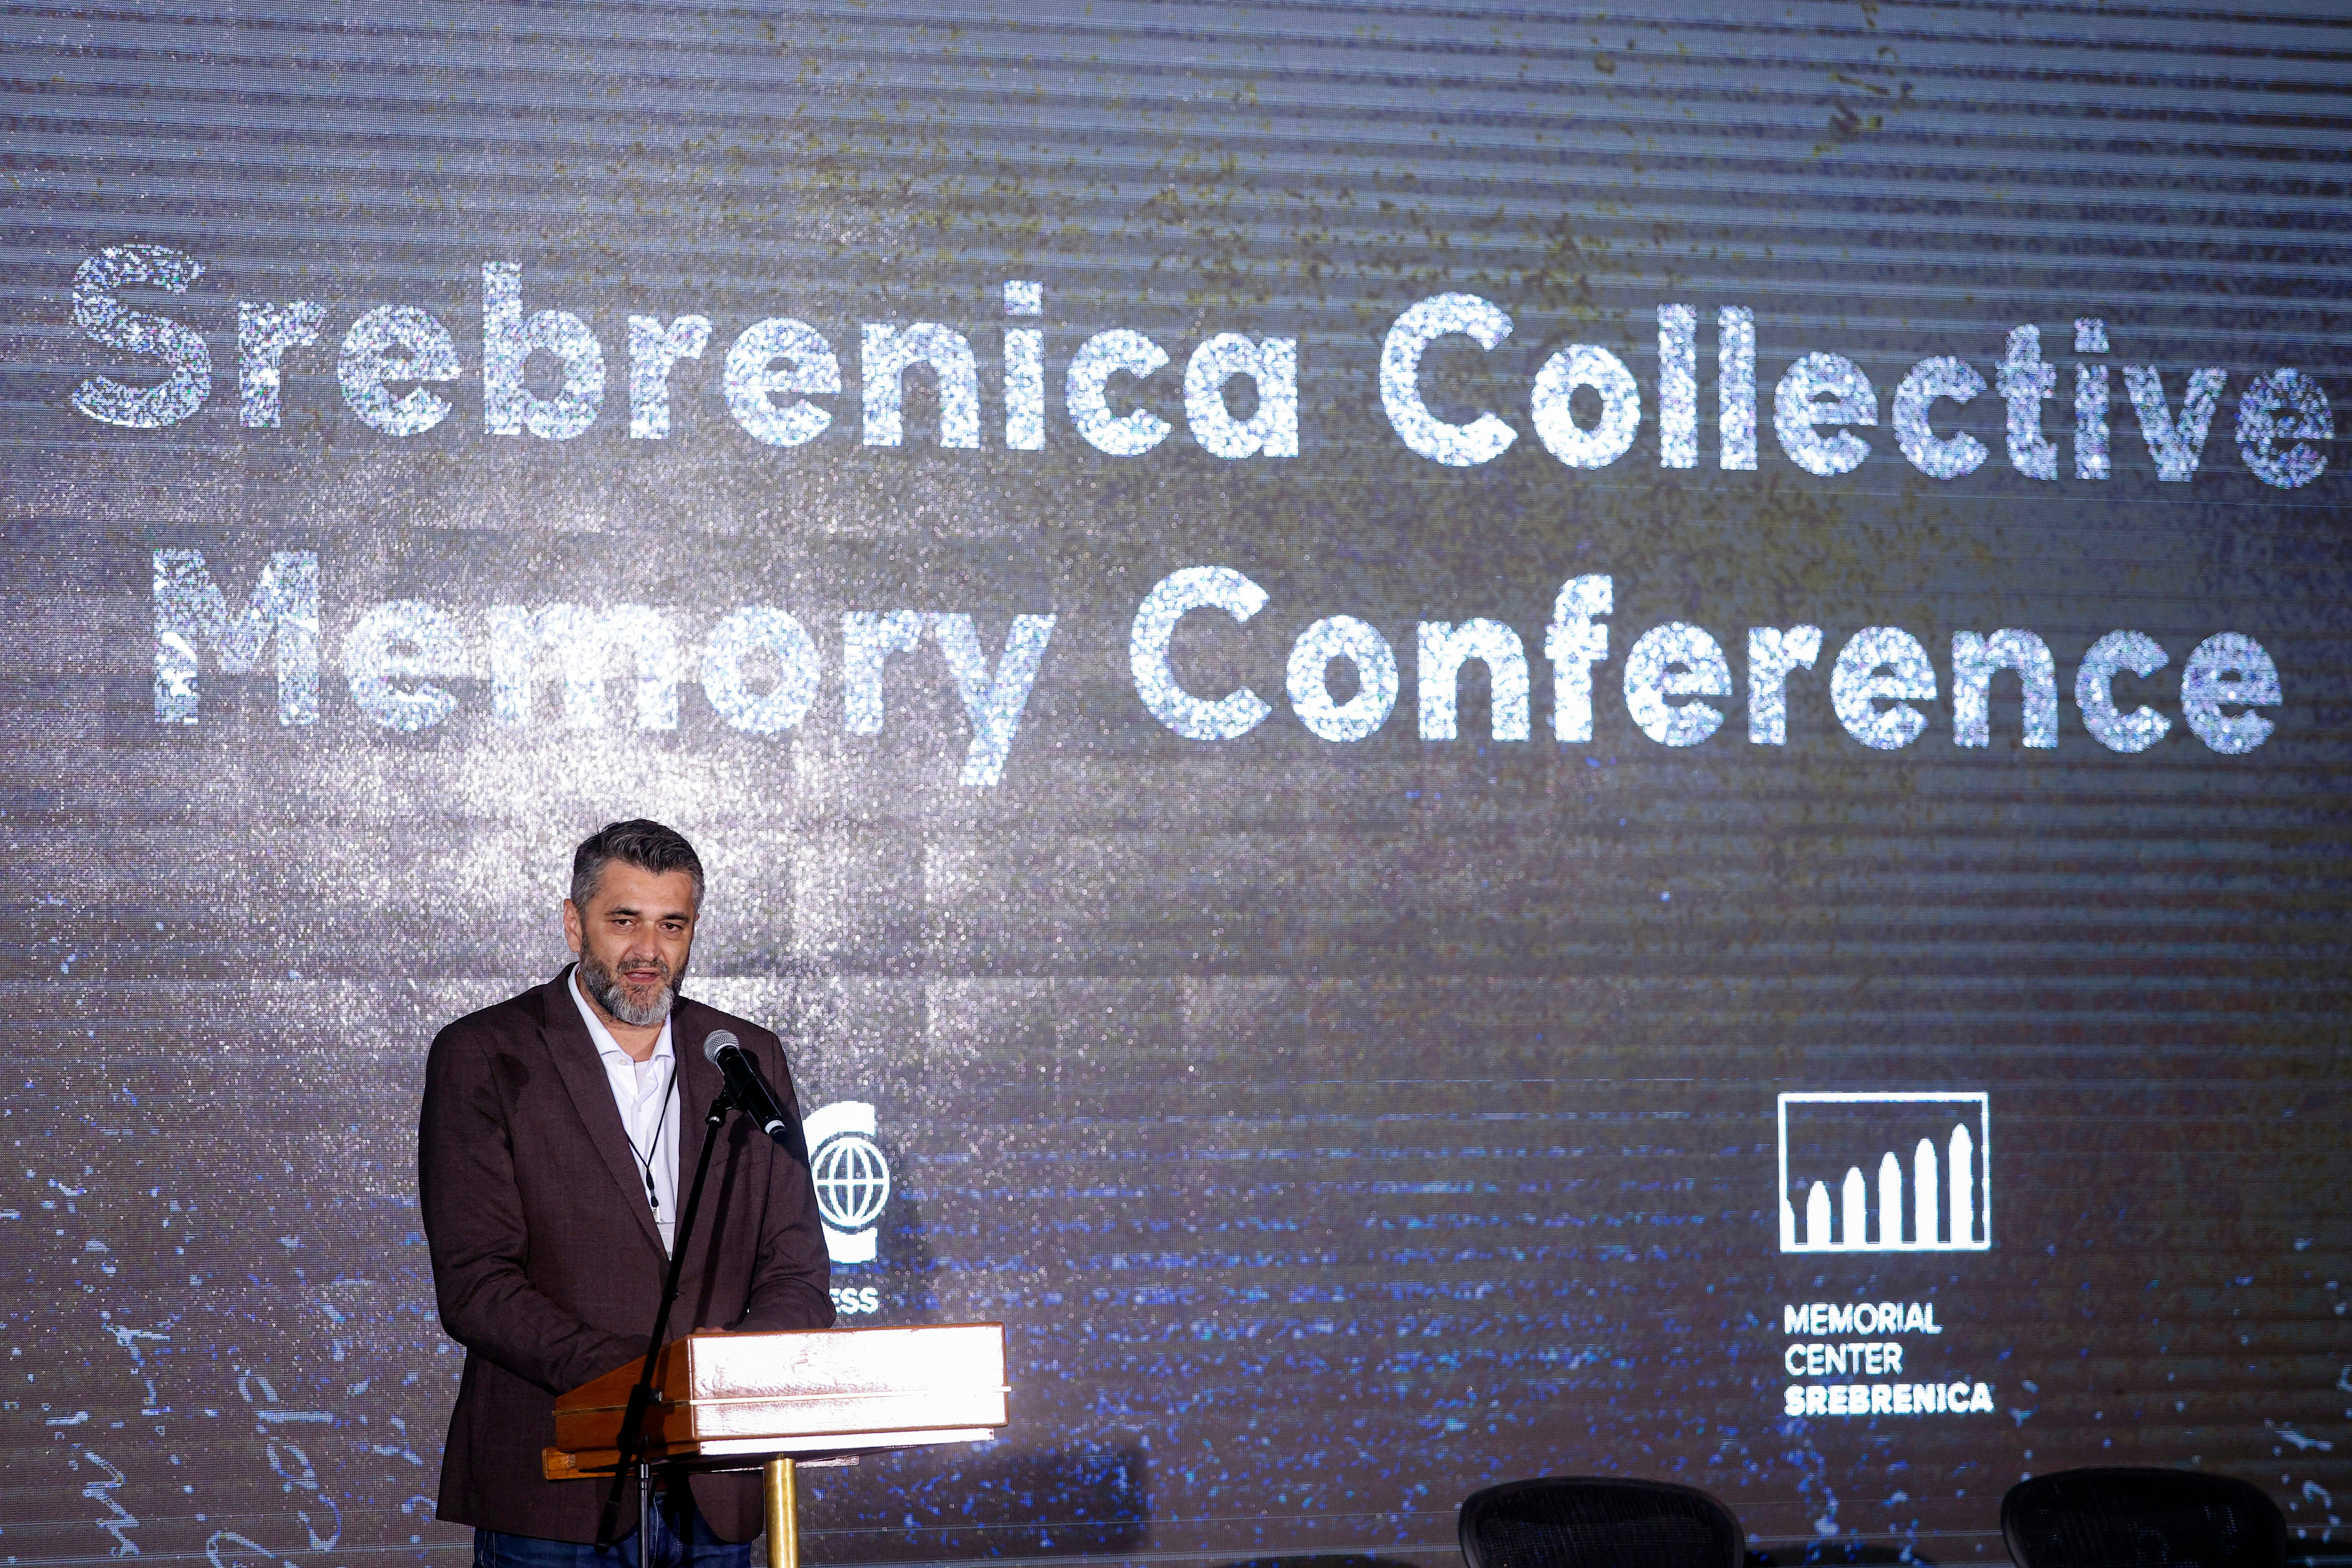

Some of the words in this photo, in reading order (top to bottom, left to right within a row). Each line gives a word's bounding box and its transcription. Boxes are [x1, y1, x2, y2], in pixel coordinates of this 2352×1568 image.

[71, 244, 1299, 458] Srebrenica
[1379, 292, 2335, 488] Collective
[154, 549, 1058, 786] Memory
[1130, 564, 2283, 753] Conference
[1784, 1302, 1943, 1334] MEMORIAL
[1785, 1342, 1903, 1375] CENTER
[1784, 1382, 1994, 1416] SREBRENICA
